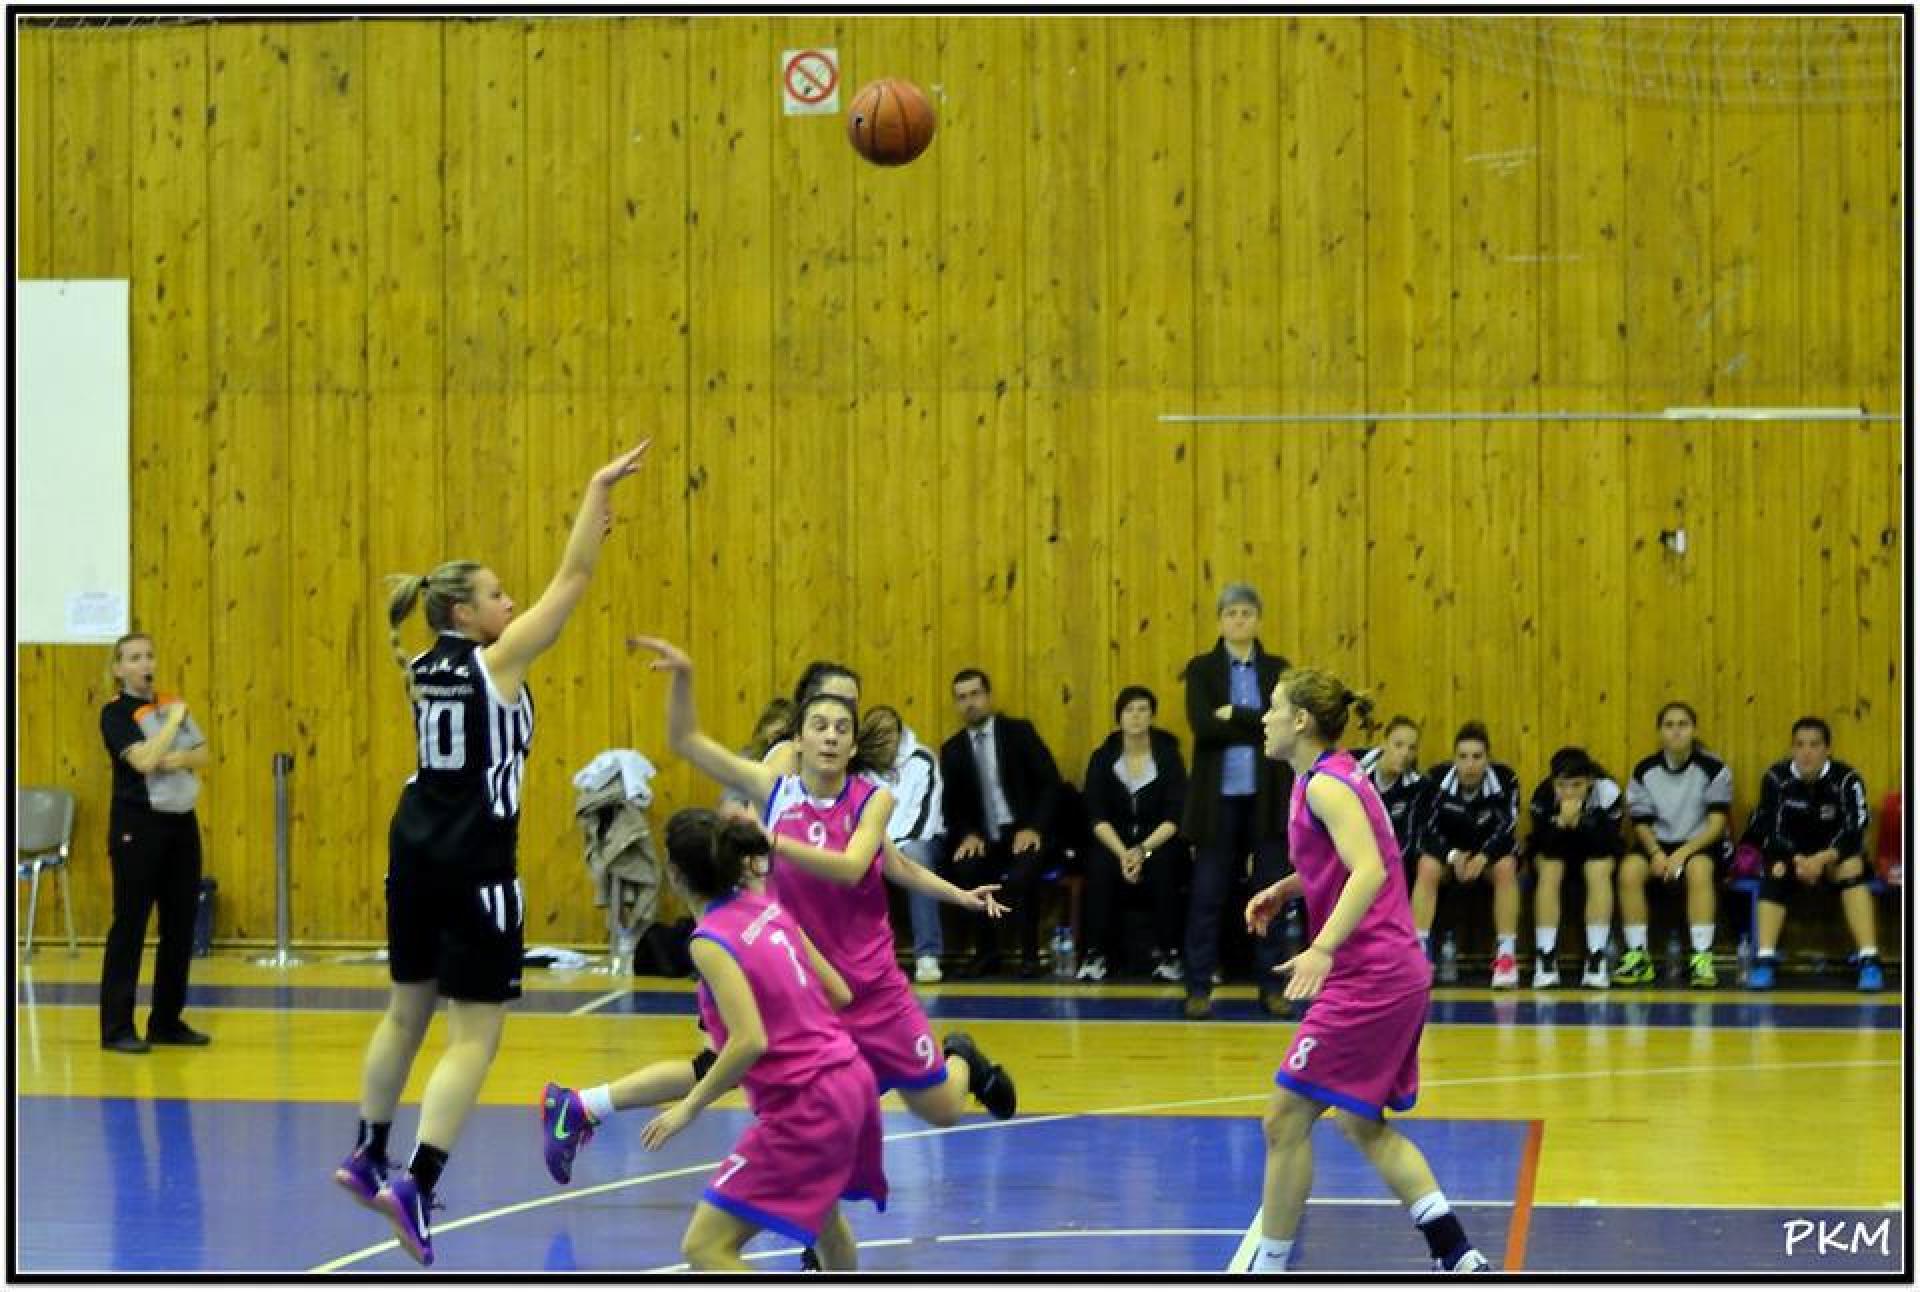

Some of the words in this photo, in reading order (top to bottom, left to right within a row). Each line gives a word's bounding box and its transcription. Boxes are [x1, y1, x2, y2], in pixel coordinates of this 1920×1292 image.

[417, 700, 465, 770] 10
[808, 822, 827, 849] 9
[915, 1034, 935, 1069] 9
[1288, 1036, 1318, 1071] 8
[713, 1153, 748, 1189] 7
